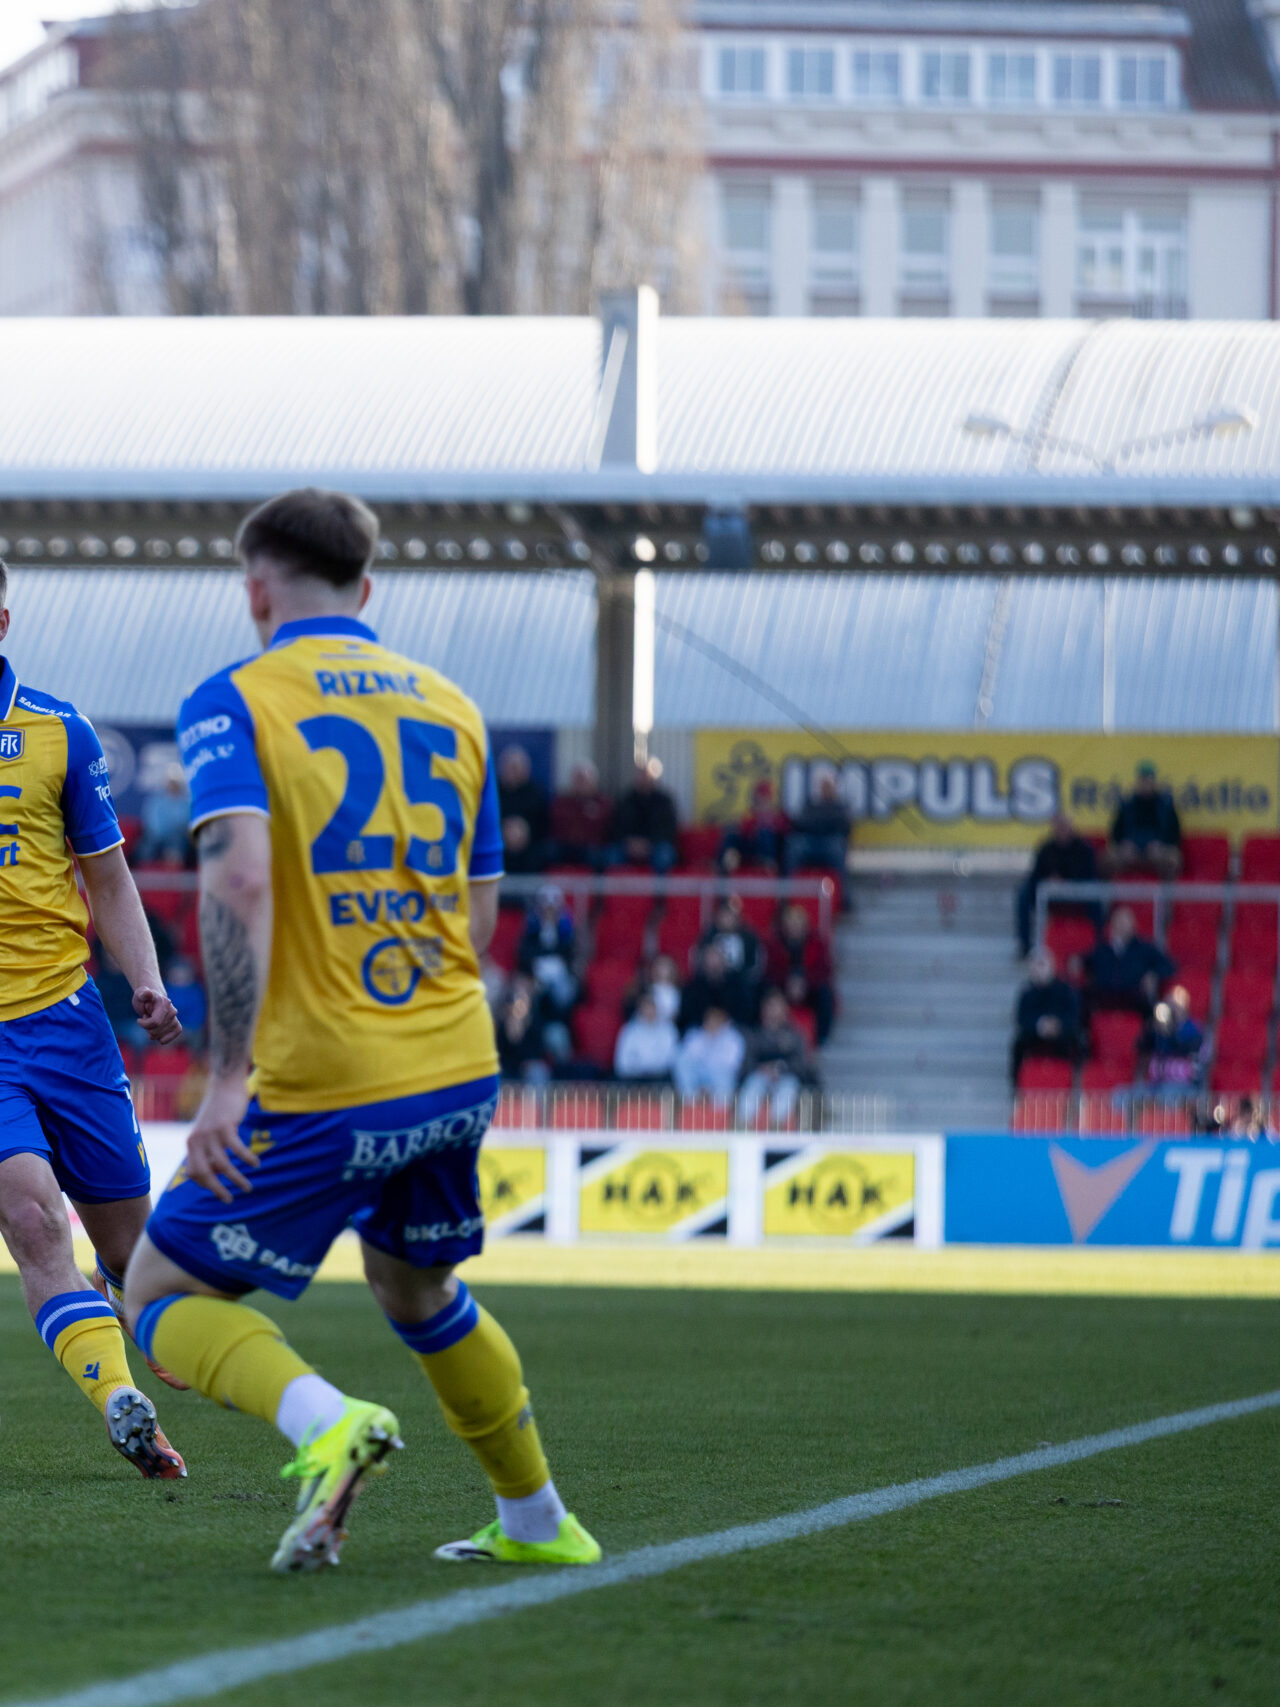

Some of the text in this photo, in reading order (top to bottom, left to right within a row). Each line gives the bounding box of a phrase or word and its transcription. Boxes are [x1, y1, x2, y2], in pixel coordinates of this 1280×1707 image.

[296, 714, 465, 877] 25
[783, 756, 1058, 822] IMPULS
[329, 888, 427, 926] EVRO
